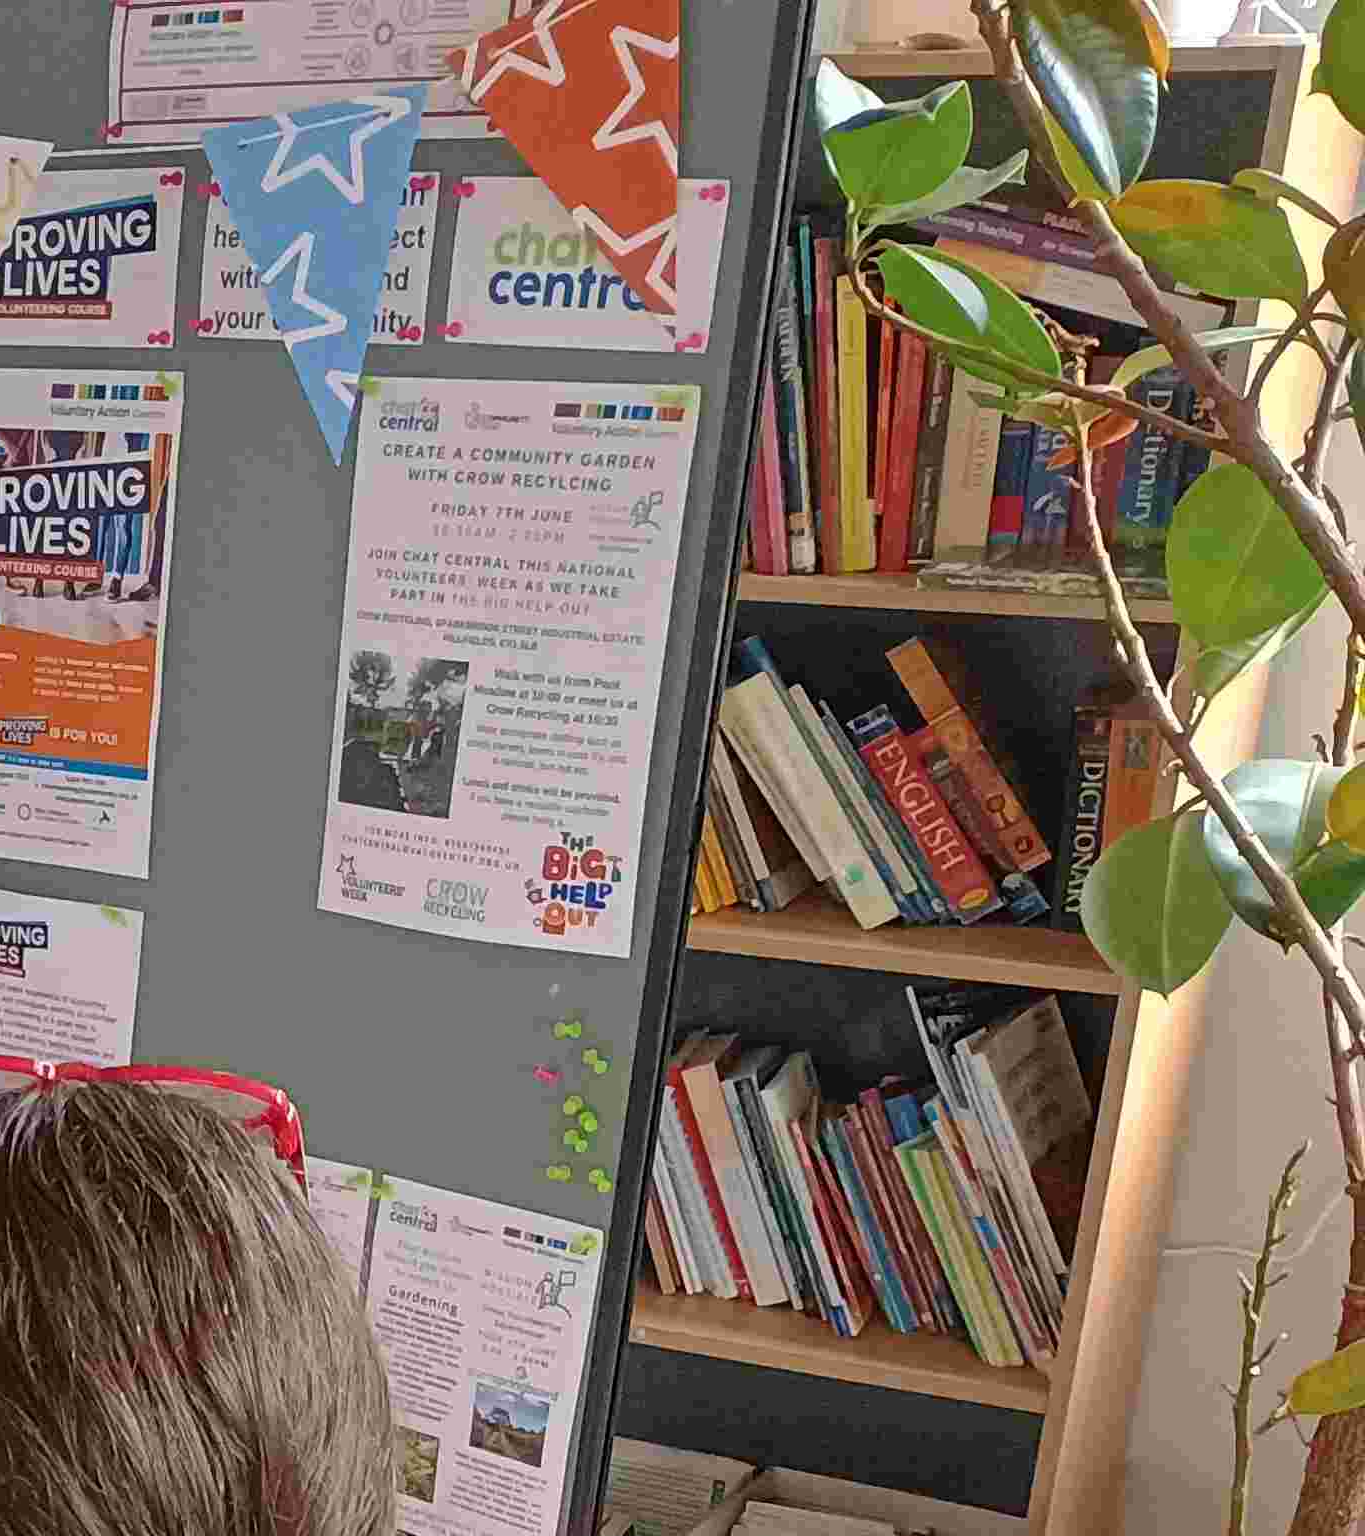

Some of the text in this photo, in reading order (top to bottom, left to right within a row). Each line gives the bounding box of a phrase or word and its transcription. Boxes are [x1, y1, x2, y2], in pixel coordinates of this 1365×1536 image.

[3, 258, 101, 297] LIVES
[382, 443, 446, 461] CREATE
[469, 447, 574, 467] COMMUNITY
[580, 453, 656, 471] GARDEN
[876, 738, 967, 871] ENGLISH
[560, 832, 594, 851] THE
[549, 881, 613, 910] HELP
